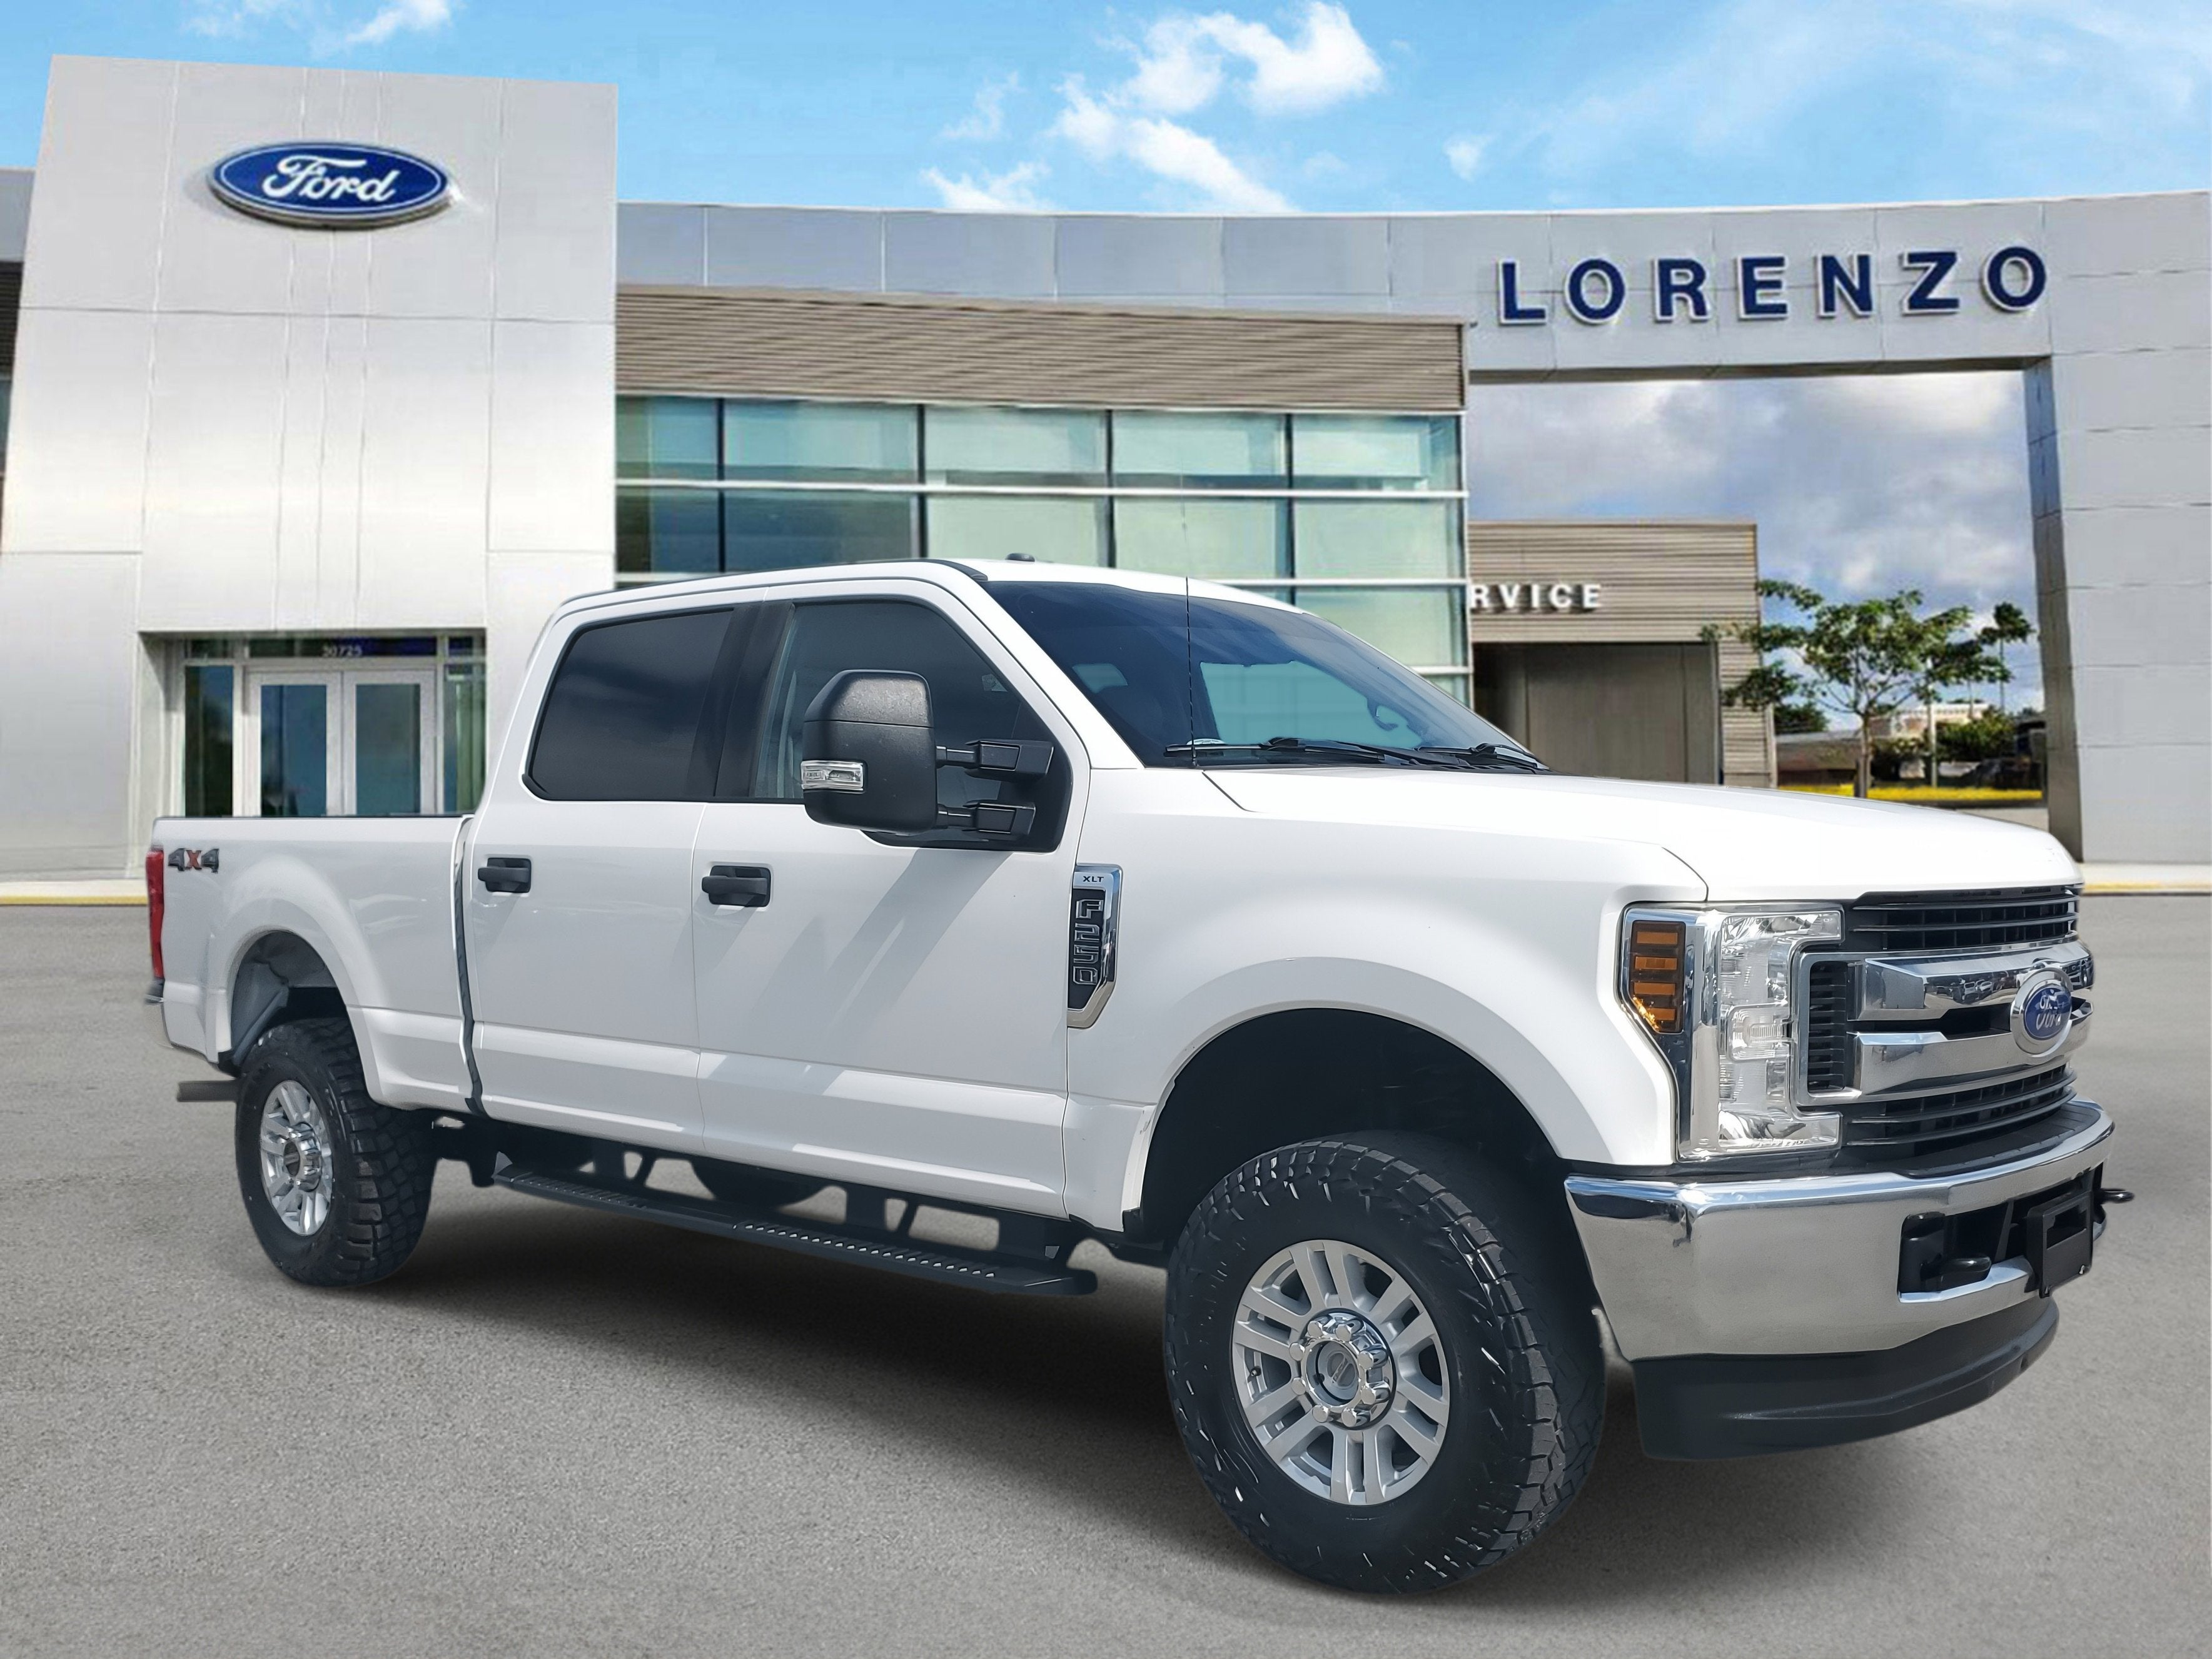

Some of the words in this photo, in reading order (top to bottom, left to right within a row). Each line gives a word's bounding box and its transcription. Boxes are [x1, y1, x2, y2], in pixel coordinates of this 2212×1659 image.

[263, 154, 400, 202] Ford
[1499, 246, 2047, 323] LORENZO
[1073, 899, 1104, 985] F250
